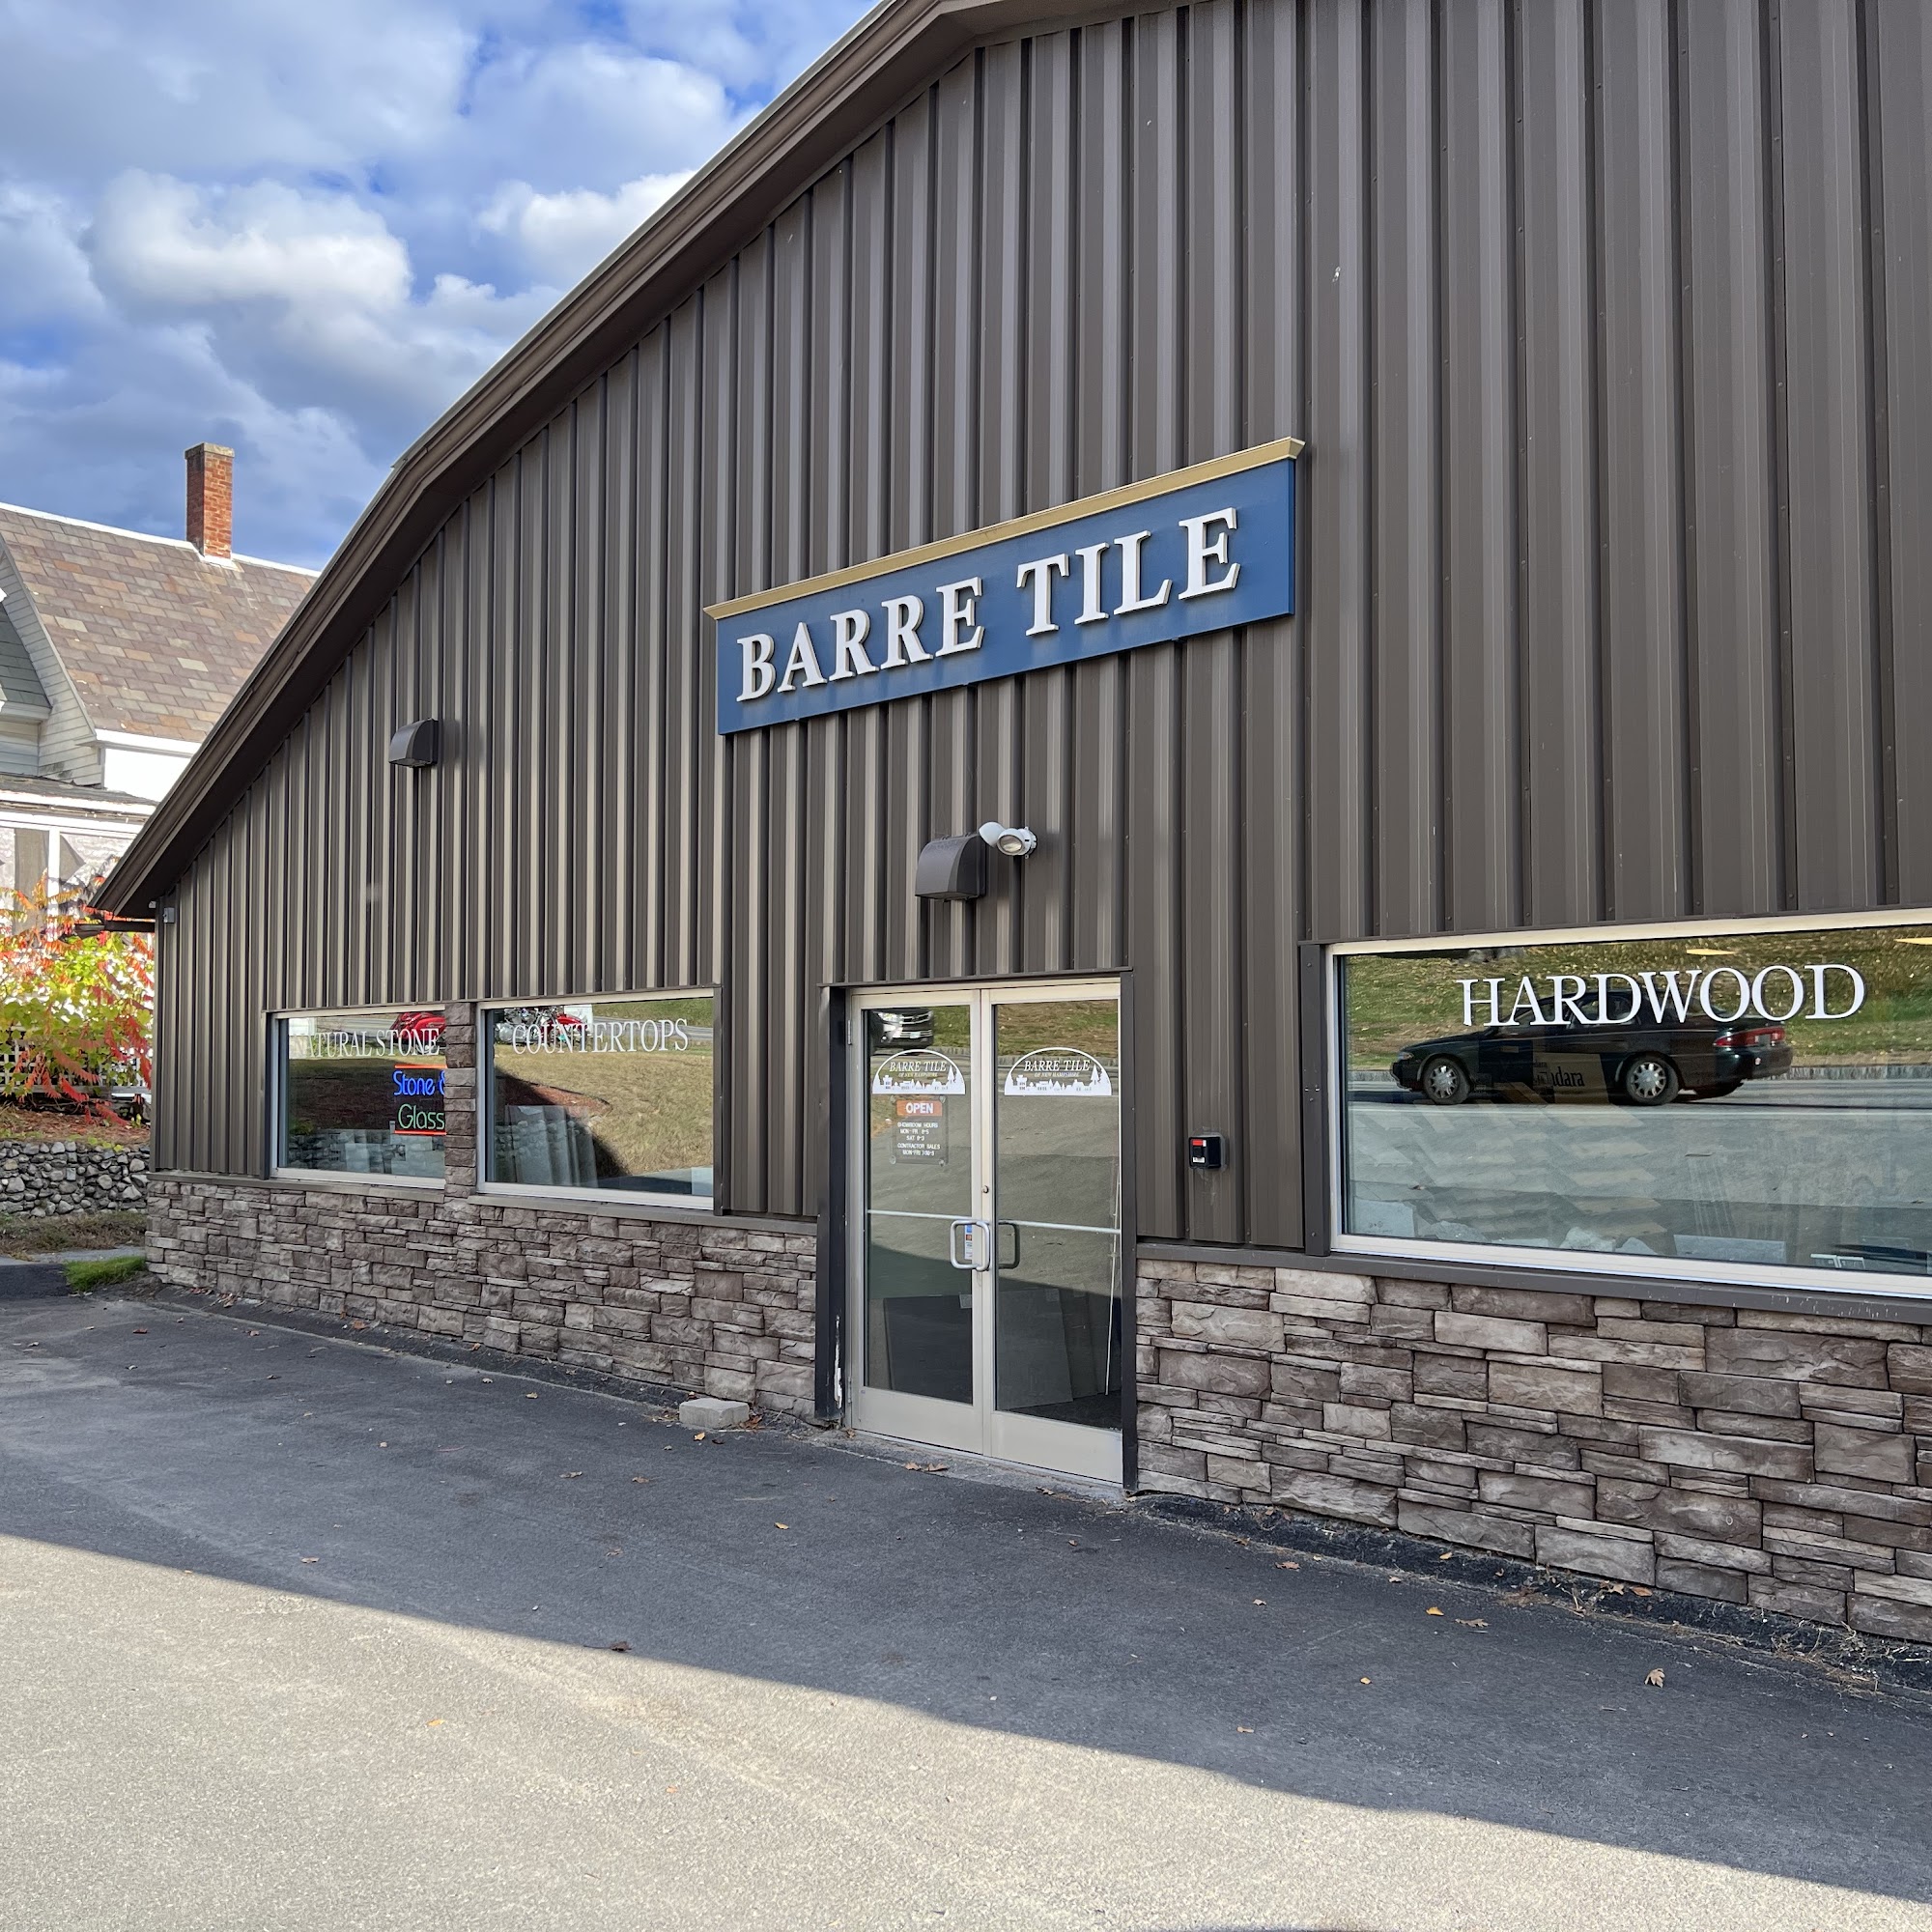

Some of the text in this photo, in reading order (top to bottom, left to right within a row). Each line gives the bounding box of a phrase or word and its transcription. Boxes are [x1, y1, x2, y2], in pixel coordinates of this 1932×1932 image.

[736, 506, 1242, 703] BARRE TILE
[1456, 964, 1867, 1027] HARDWOOD
[376, 1028, 440, 1057] STONE
[512, 1017, 689, 1055] COUNTERTOPS
[889, 1061, 948, 1072] BARRE TILE
[1024, 1059, 1091, 1072] BARRE TILE
[392, 1070, 436, 1096] Stone
[398, 1103, 445, 1130] Glass
[905, 1102, 934, 1114] OPEN
